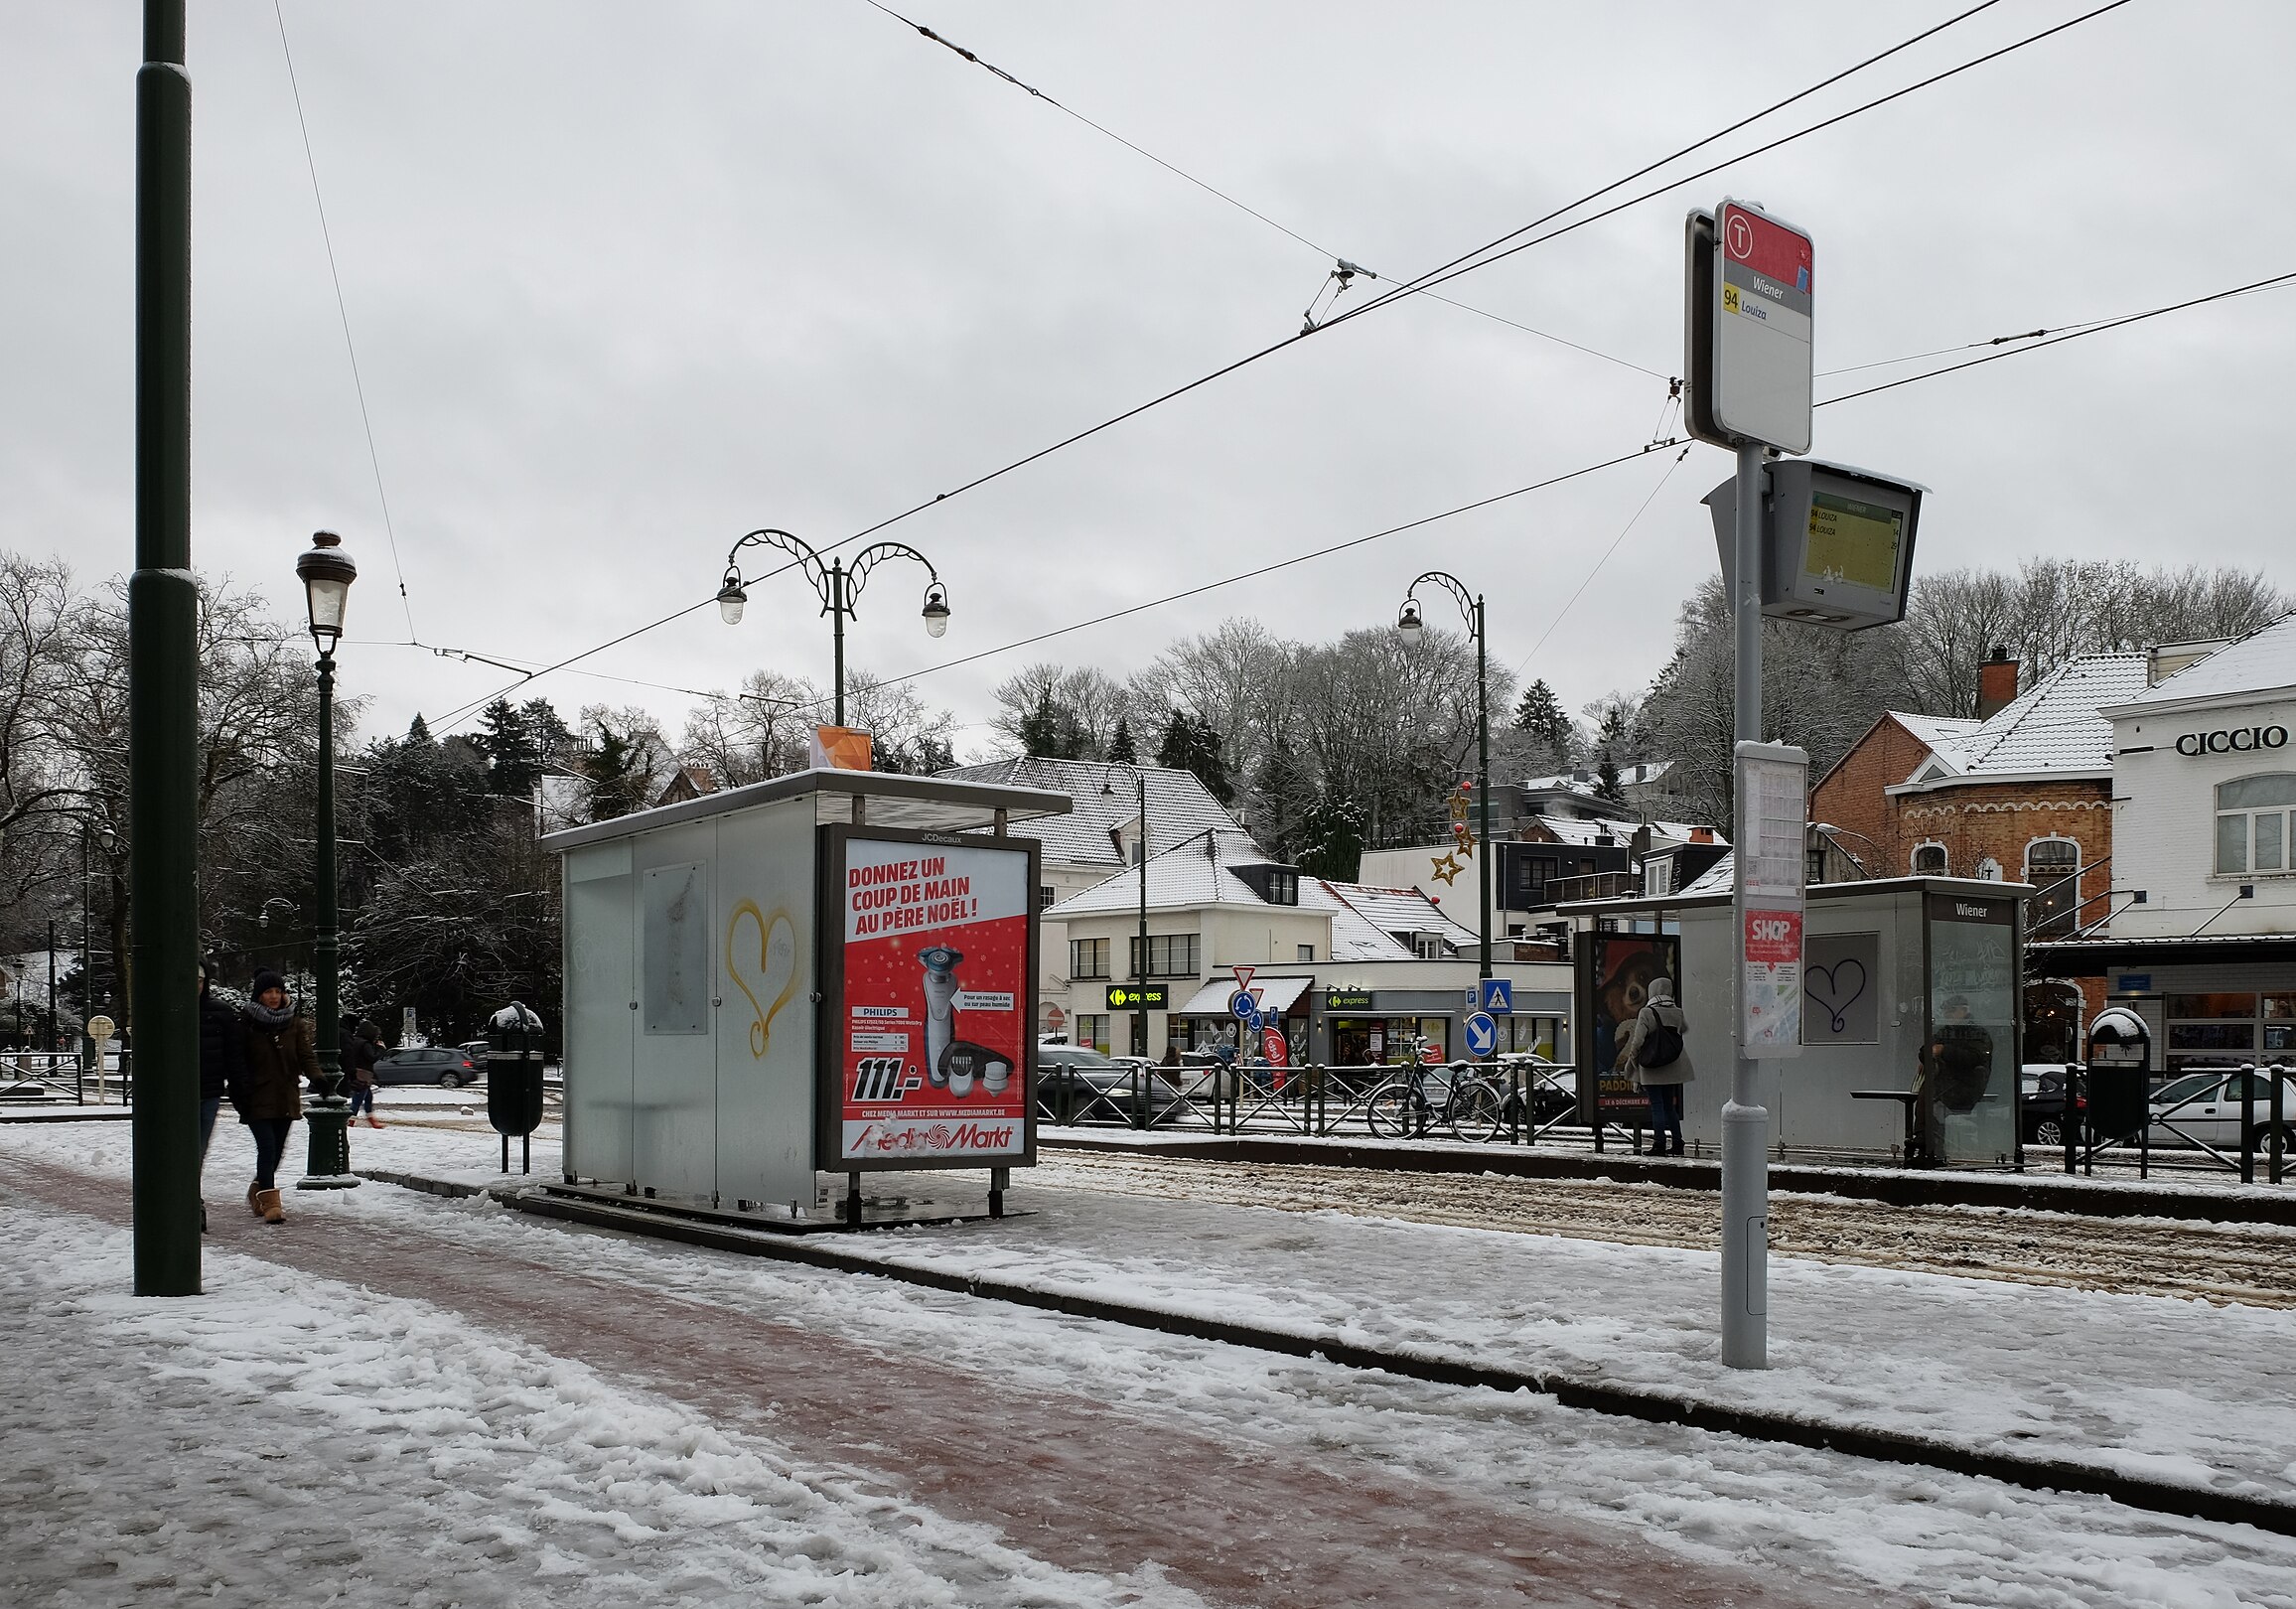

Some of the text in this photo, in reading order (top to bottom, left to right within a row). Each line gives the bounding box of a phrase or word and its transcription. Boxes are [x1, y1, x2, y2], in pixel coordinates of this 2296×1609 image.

[1734, 224, 1746, 248] T
[1753, 276, 1784, 300] Wiener
[1724, 290, 1767, 320] 94 Louiza
[1818, 512, 1837, 521] LOUIZA
[1817, 525, 1835, 536] LOUIZA
[2176, 725, 2288, 756] CICCIO
[922, 833, 962, 844] JCDecaux
[849, 857, 945, 888] DONNEZ UN
[852, 876, 970, 912] COUP DE MAIN
[856, 898, 977, 936] AU PÈRE NOËL !
[1955, 903, 1987, 918] Wiener
[1752, 920, 1791, 941] SHOP
[1128, 993, 1162, 1003] expess
[1271, 1008, 1275, 1018] P
[946, 1123, 1013, 1148] Markt
